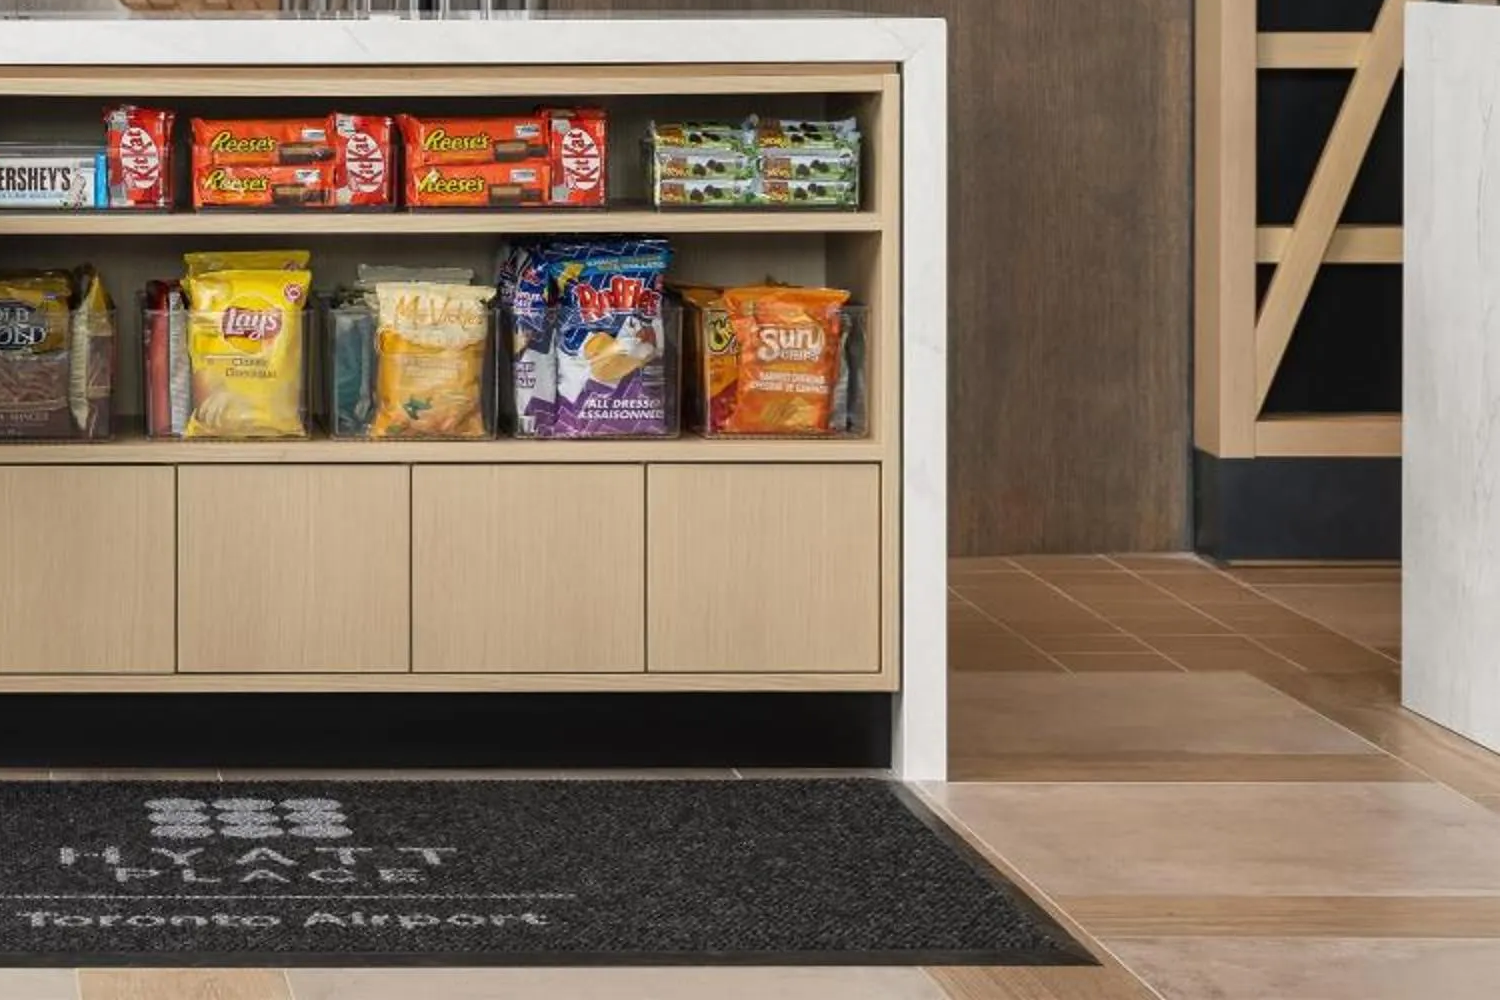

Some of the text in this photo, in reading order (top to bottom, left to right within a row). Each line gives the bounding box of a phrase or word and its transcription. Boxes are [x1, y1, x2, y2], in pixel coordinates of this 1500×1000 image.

[211, 131, 276, 153] Reese's
[424, 129, 491, 152] Reese's
[204, 169, 269, 192] Reese's
[418, 166, 485, 193] Reese's
[577, 275, 660, 323] Ruffles
[59, 846, 457, 866] HYATT
[115, 867, 426, 885] PLACE
[15, 911, 553, 930] Toronto Airport
